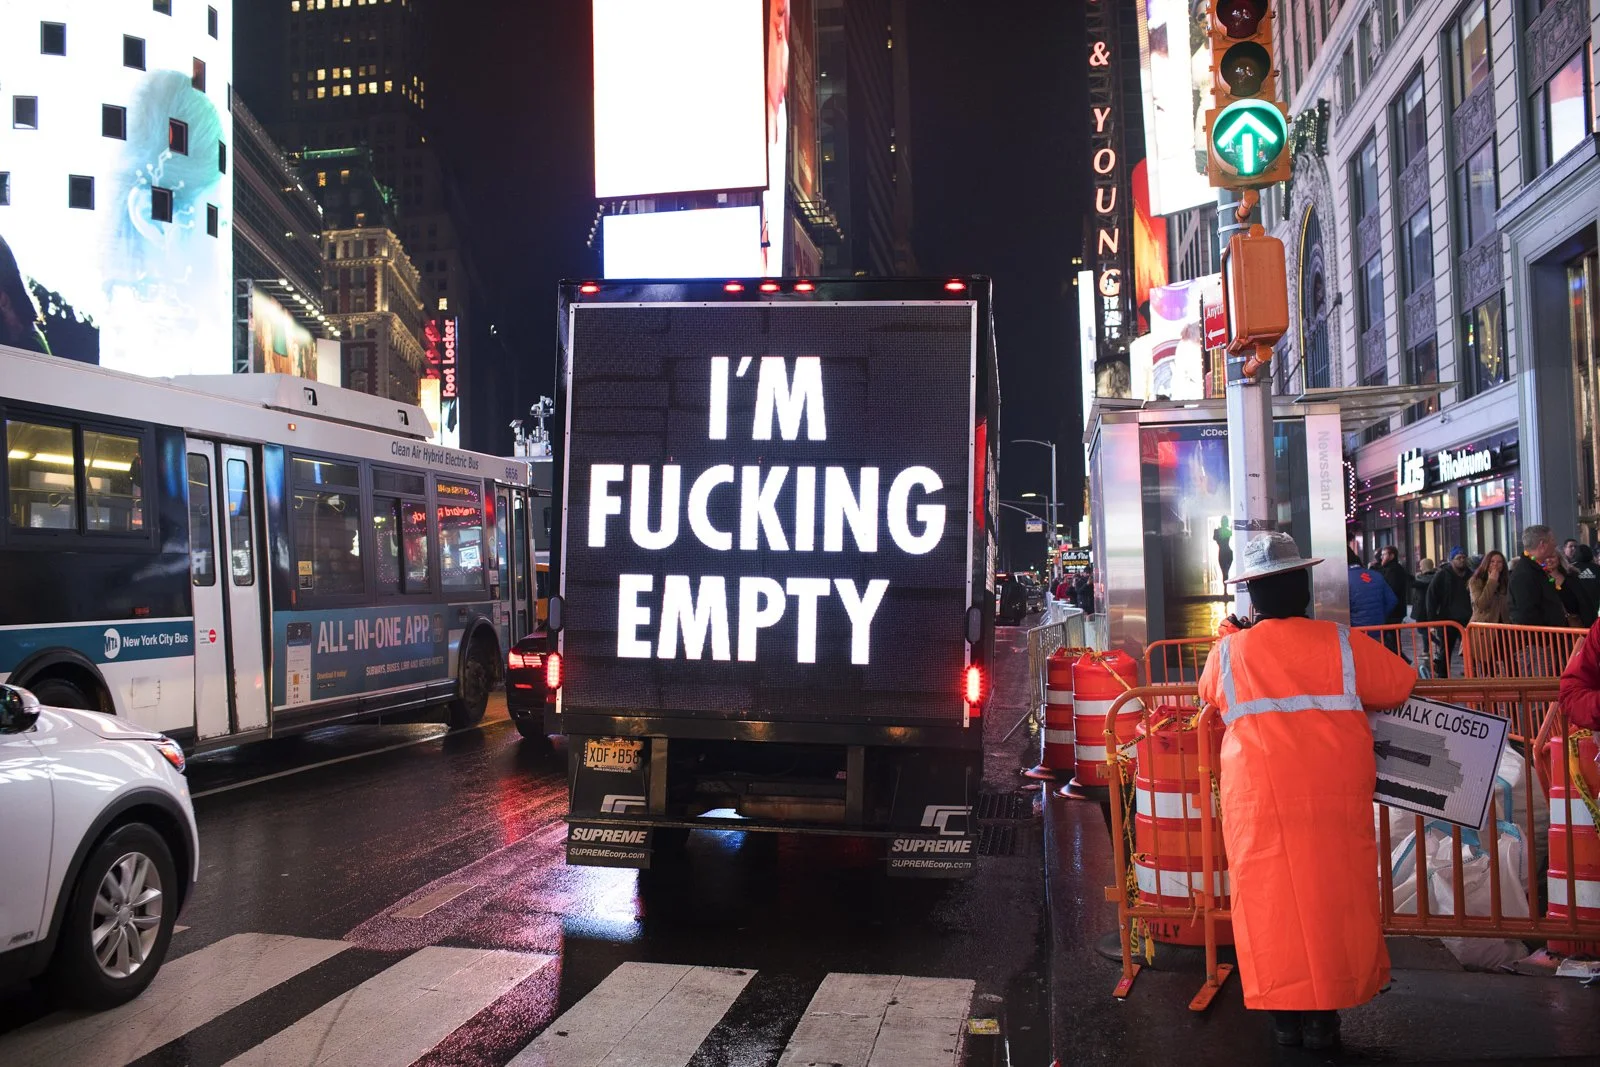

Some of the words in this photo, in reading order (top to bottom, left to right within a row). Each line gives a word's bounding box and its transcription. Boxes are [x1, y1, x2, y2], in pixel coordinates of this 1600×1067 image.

[1093, 107, 1121, 297] YOUNG
[1206, 304, 1224, 319] Anyti
[442, 319, 455, 364] Locker
[443, 368, 455, 397] Foot
[709, 356, 826, 440] I'M
[1201, 429, 1228, 437] JCDec
[391, 441, 411, 456] Clean
[411, 445, 422, 458] Air
[423, 447, 443, 464] Hybrid
[445, 453, 467, 468] Electric
[468, 459, 479, 470] Bus
[1318, 430, 1334, 511] Newsstand
[588, 464, 946, 555] FUCKING
[617, 574, 890, 665] EMPTY
[104, 636, 118, 652] MTA
[123, 636, 140, 648] New
[141, 634, 158, 646] York
[159, 633, 173, 646] City
[174, 632, 189, 644] Bus
[317, 617, 401, 654] ALL-IN-ONE
[405, 615, 430, 644] APP.
[1434, 712, 1489, 739] CLOSED
[590, 747, 610, 763] XDF
[571, 827, 647, 844] SUPREME
[892, 839, 972, 853] SUPREME
[569, 847, 645, 860] SUPREMEcorp.com
[892, 859, 971, 870] SUPREMEcorp.com
